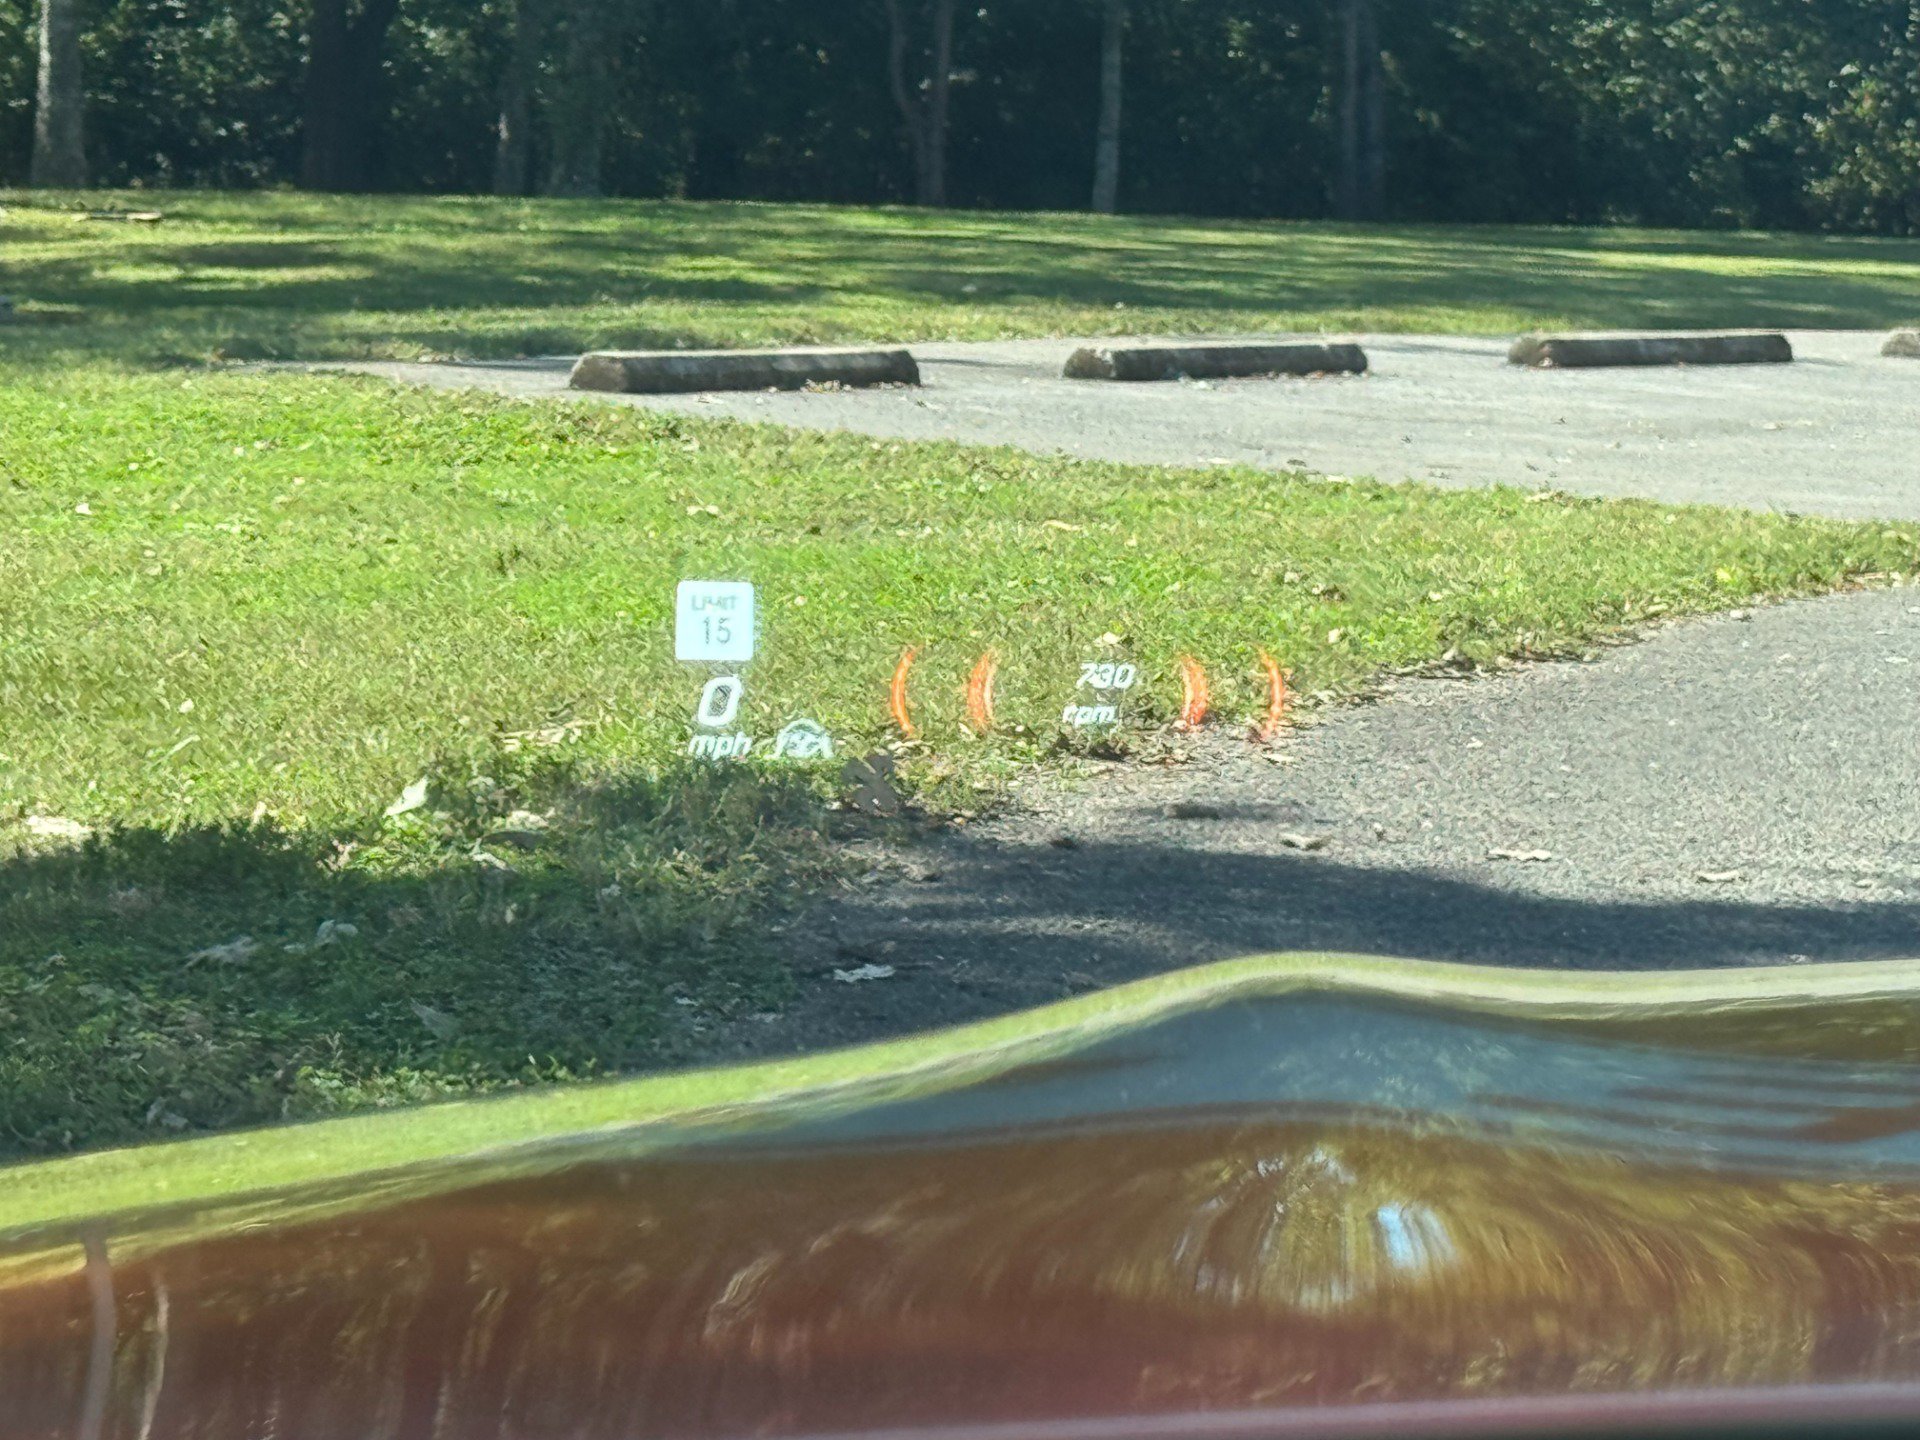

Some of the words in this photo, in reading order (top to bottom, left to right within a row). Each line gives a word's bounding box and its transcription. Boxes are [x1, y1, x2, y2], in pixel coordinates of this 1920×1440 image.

[703, 616, 732, 645] 15
[1076, 662, 1137, 689] 730
[697, 675, 743, 727] 0
[1062, 704, 1117, 728] rpm
[688, 731, 752, 760] mph
